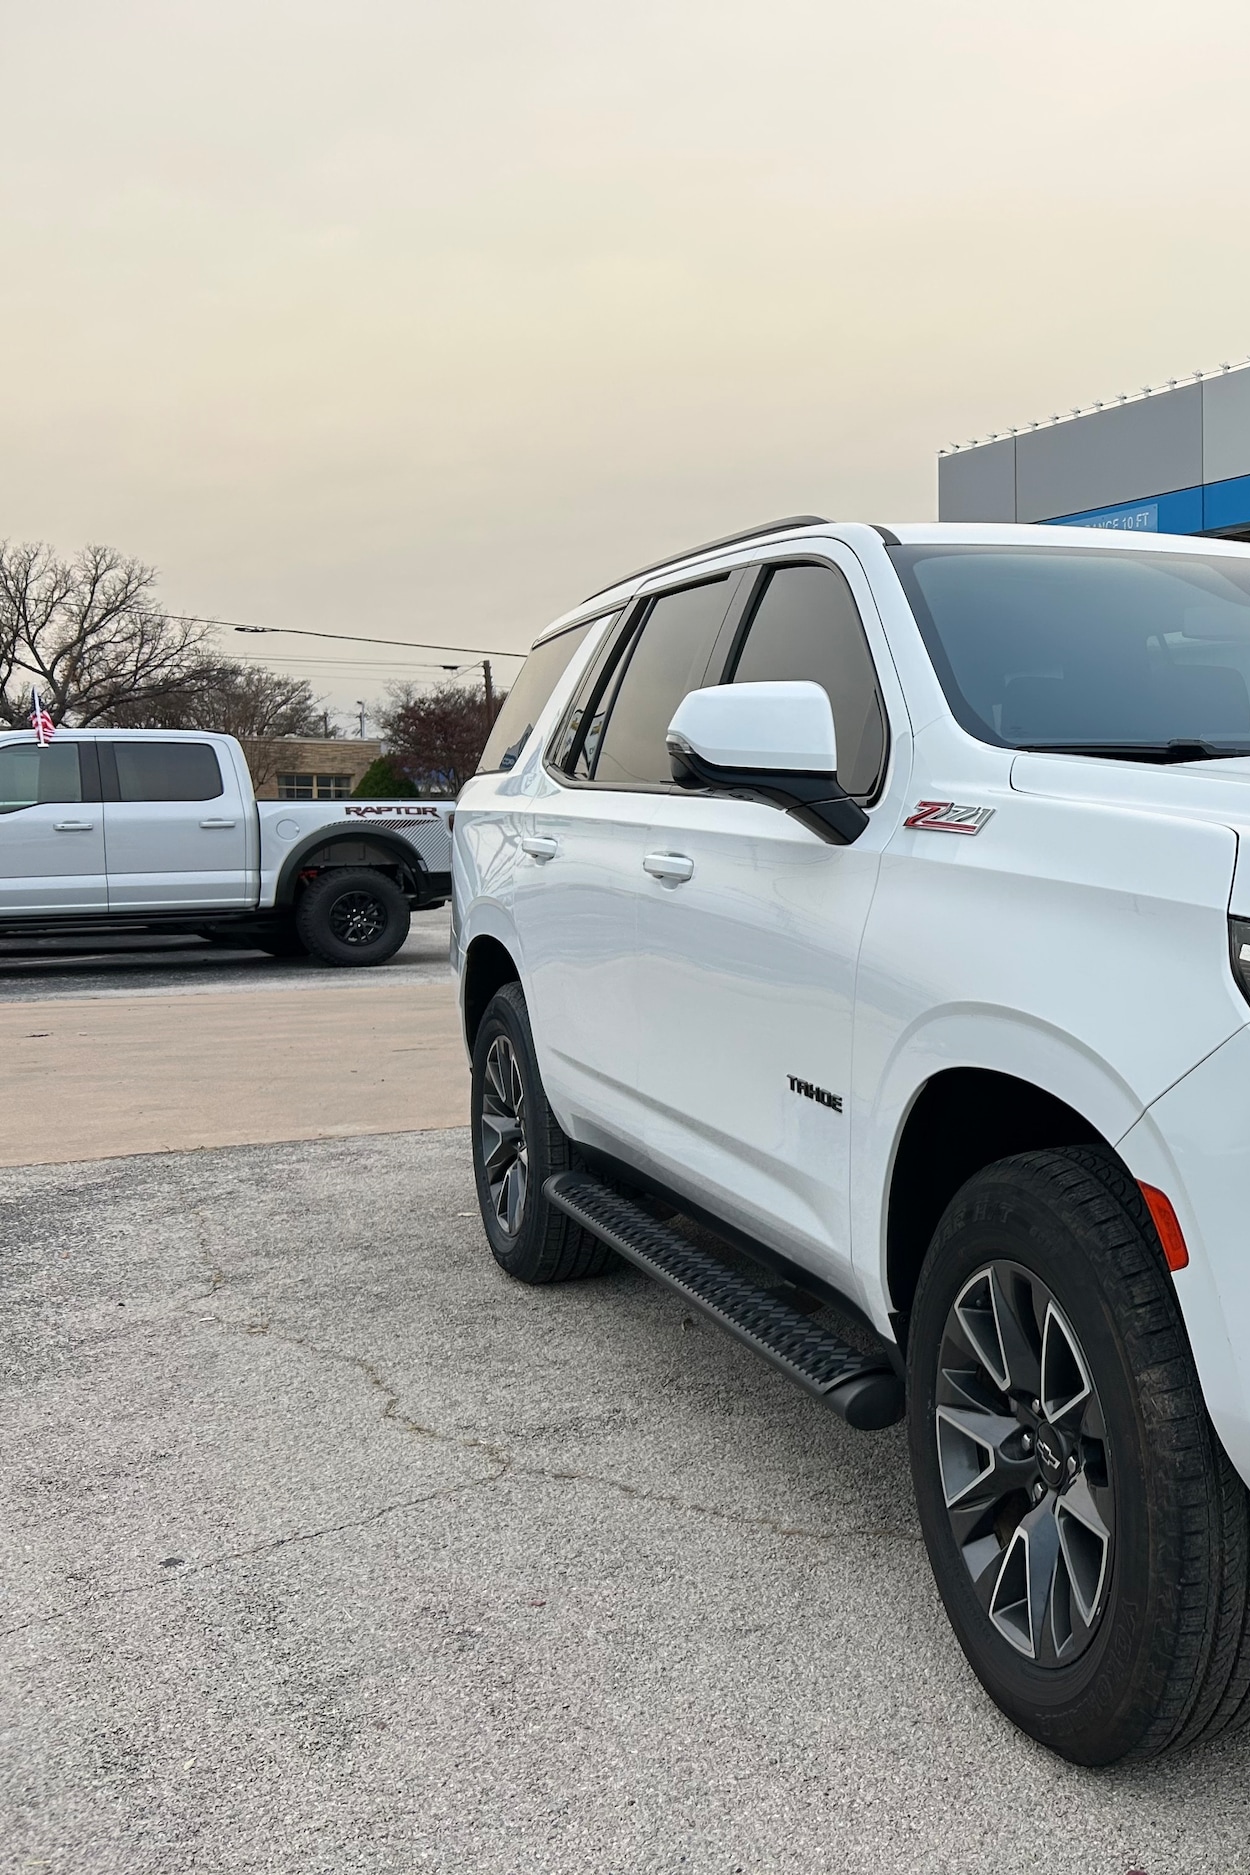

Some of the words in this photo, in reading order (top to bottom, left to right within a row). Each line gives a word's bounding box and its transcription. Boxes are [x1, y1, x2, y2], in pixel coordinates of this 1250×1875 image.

[1122, 516, 1134, 531] 10
[1136, 512, 1150, 528] FT
[344, 806, 442, 819] RAPTOR
[902, 800, 997, 836] Z71
[786, 1074, 843, 1114] TAHOE
